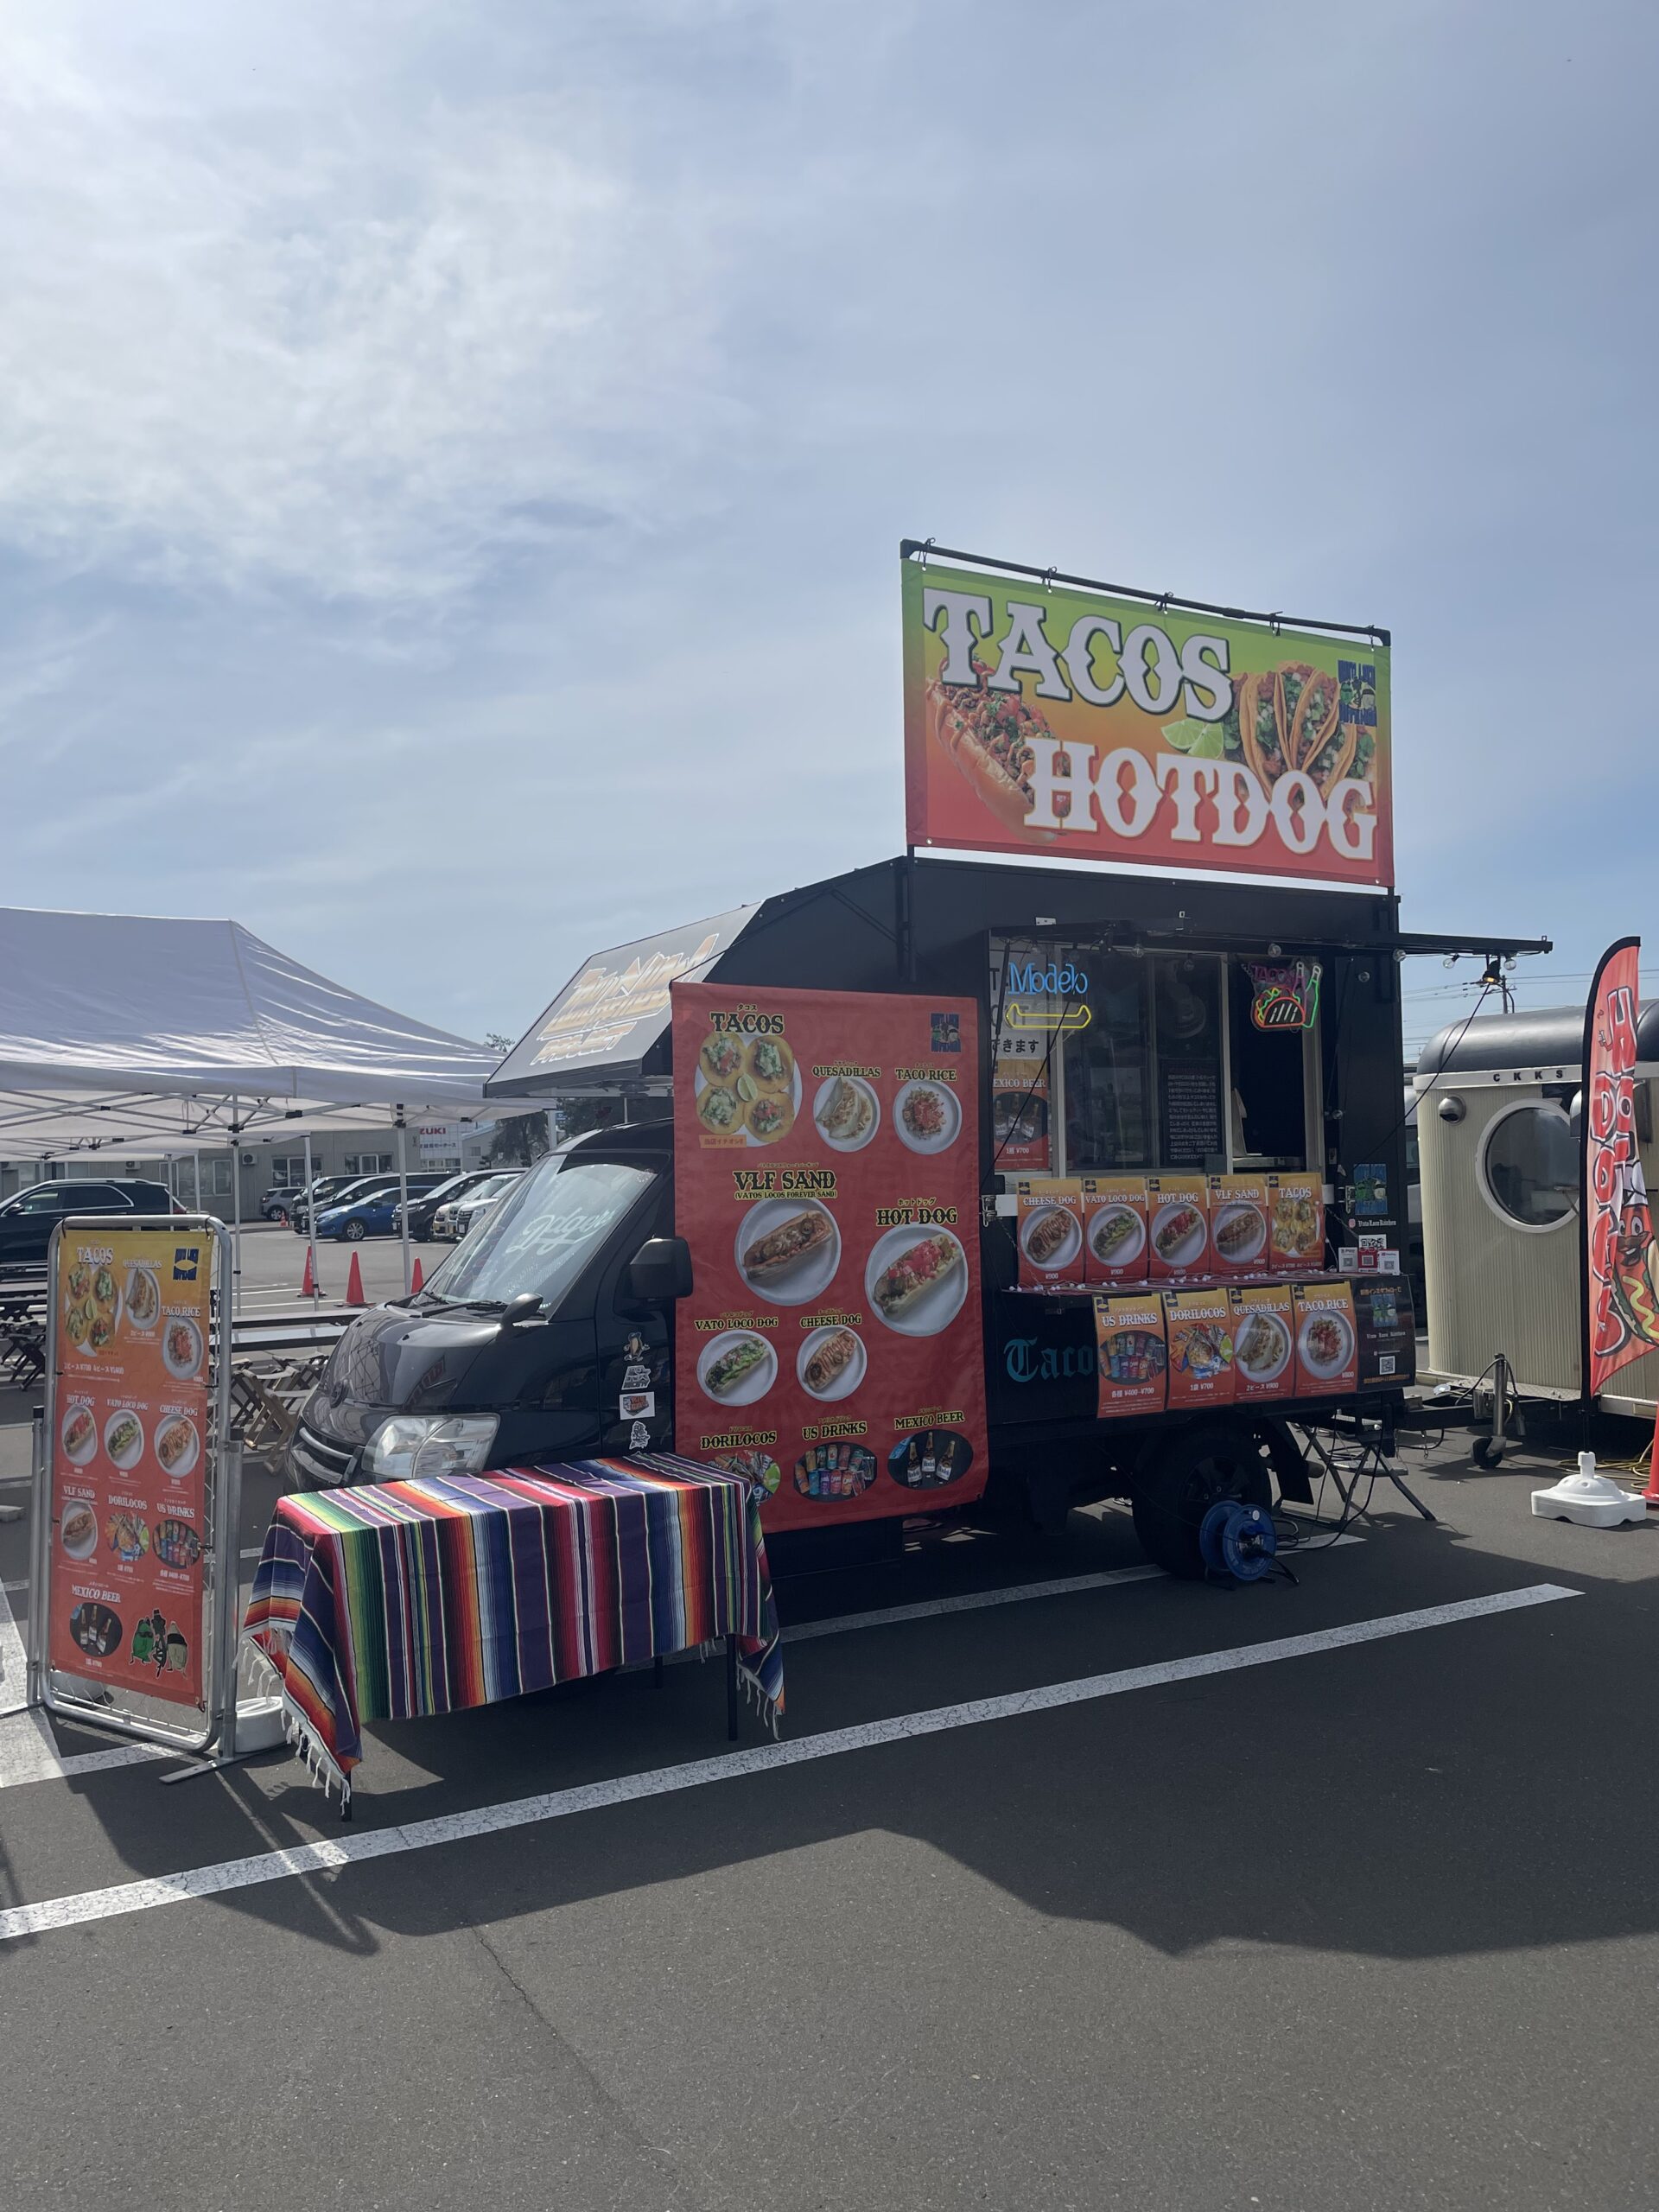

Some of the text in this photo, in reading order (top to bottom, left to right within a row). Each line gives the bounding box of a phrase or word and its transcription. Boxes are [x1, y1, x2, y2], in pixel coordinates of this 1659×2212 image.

[923, 587, 1234, 721] TACOS
[1024, 737, 1377, 860] HOTDOG
[1007, 963, 1088, 995] Modelo
[710, 1013, 784, 1034] TACOS
[812, 1066, 880, 1077] QUESADILLAS
[896, 1069, 957, 1080] TACO RICE
[993, 1079, 1046, 1088] EXICO BEER
[734, 1171, 836, 1190] VLF SAND
[1157, 1193, 1198, 1204] HOT DOG
[1215, 1189, 1259, 1200] VLF SAND
[1279, 1186, 1312, 1199] TACOS
[899, 1198, 936, 1206] ホットドッグ
[1023, 1196, 1077, 1206] CHEESE DOG
[877, 1208, 957, 1225] HOT DOG
[77, 1247, 113, 1265] TACOS
[162, 1306, 200, 1317] TACO RICE
[1233, 1302, 1290, 1316] QUESADILLAS
[1298, 1299, 1348, 1312] TACO RICE
[801, 1314, 861, 1327] CHEESE DOG
[1102, 1313, 1158, 1327] US DRINKS
[1169, 1307, 1226, 1321] DORILOCOS
[695, 1318, 779, 1330] VATO LOCO DOG
[1003, 1336, 1093, 1382] Taco
[67, 1394, 95, 1407] HOT DOG
[122, 1400, 137, 1409] LOCO
[137, 1402, 149, 1410] DOG
[160, 1404, 198, 1416] CHEESE DOG
[895, 1411, 965, 1430] MEXICO BEER
[802, 1422, 867, 1440] US DRINKS
[701, 1432, 777, 1450] DORILOCOS
[63, 1485, 95, 1499] VLF SAND
[108, 1495, 147, 1510] DORILOCOS
[156, 1503, 194, 1518] US DRINKS
[72, 1585, 121, 1603] MEXICO BEER
